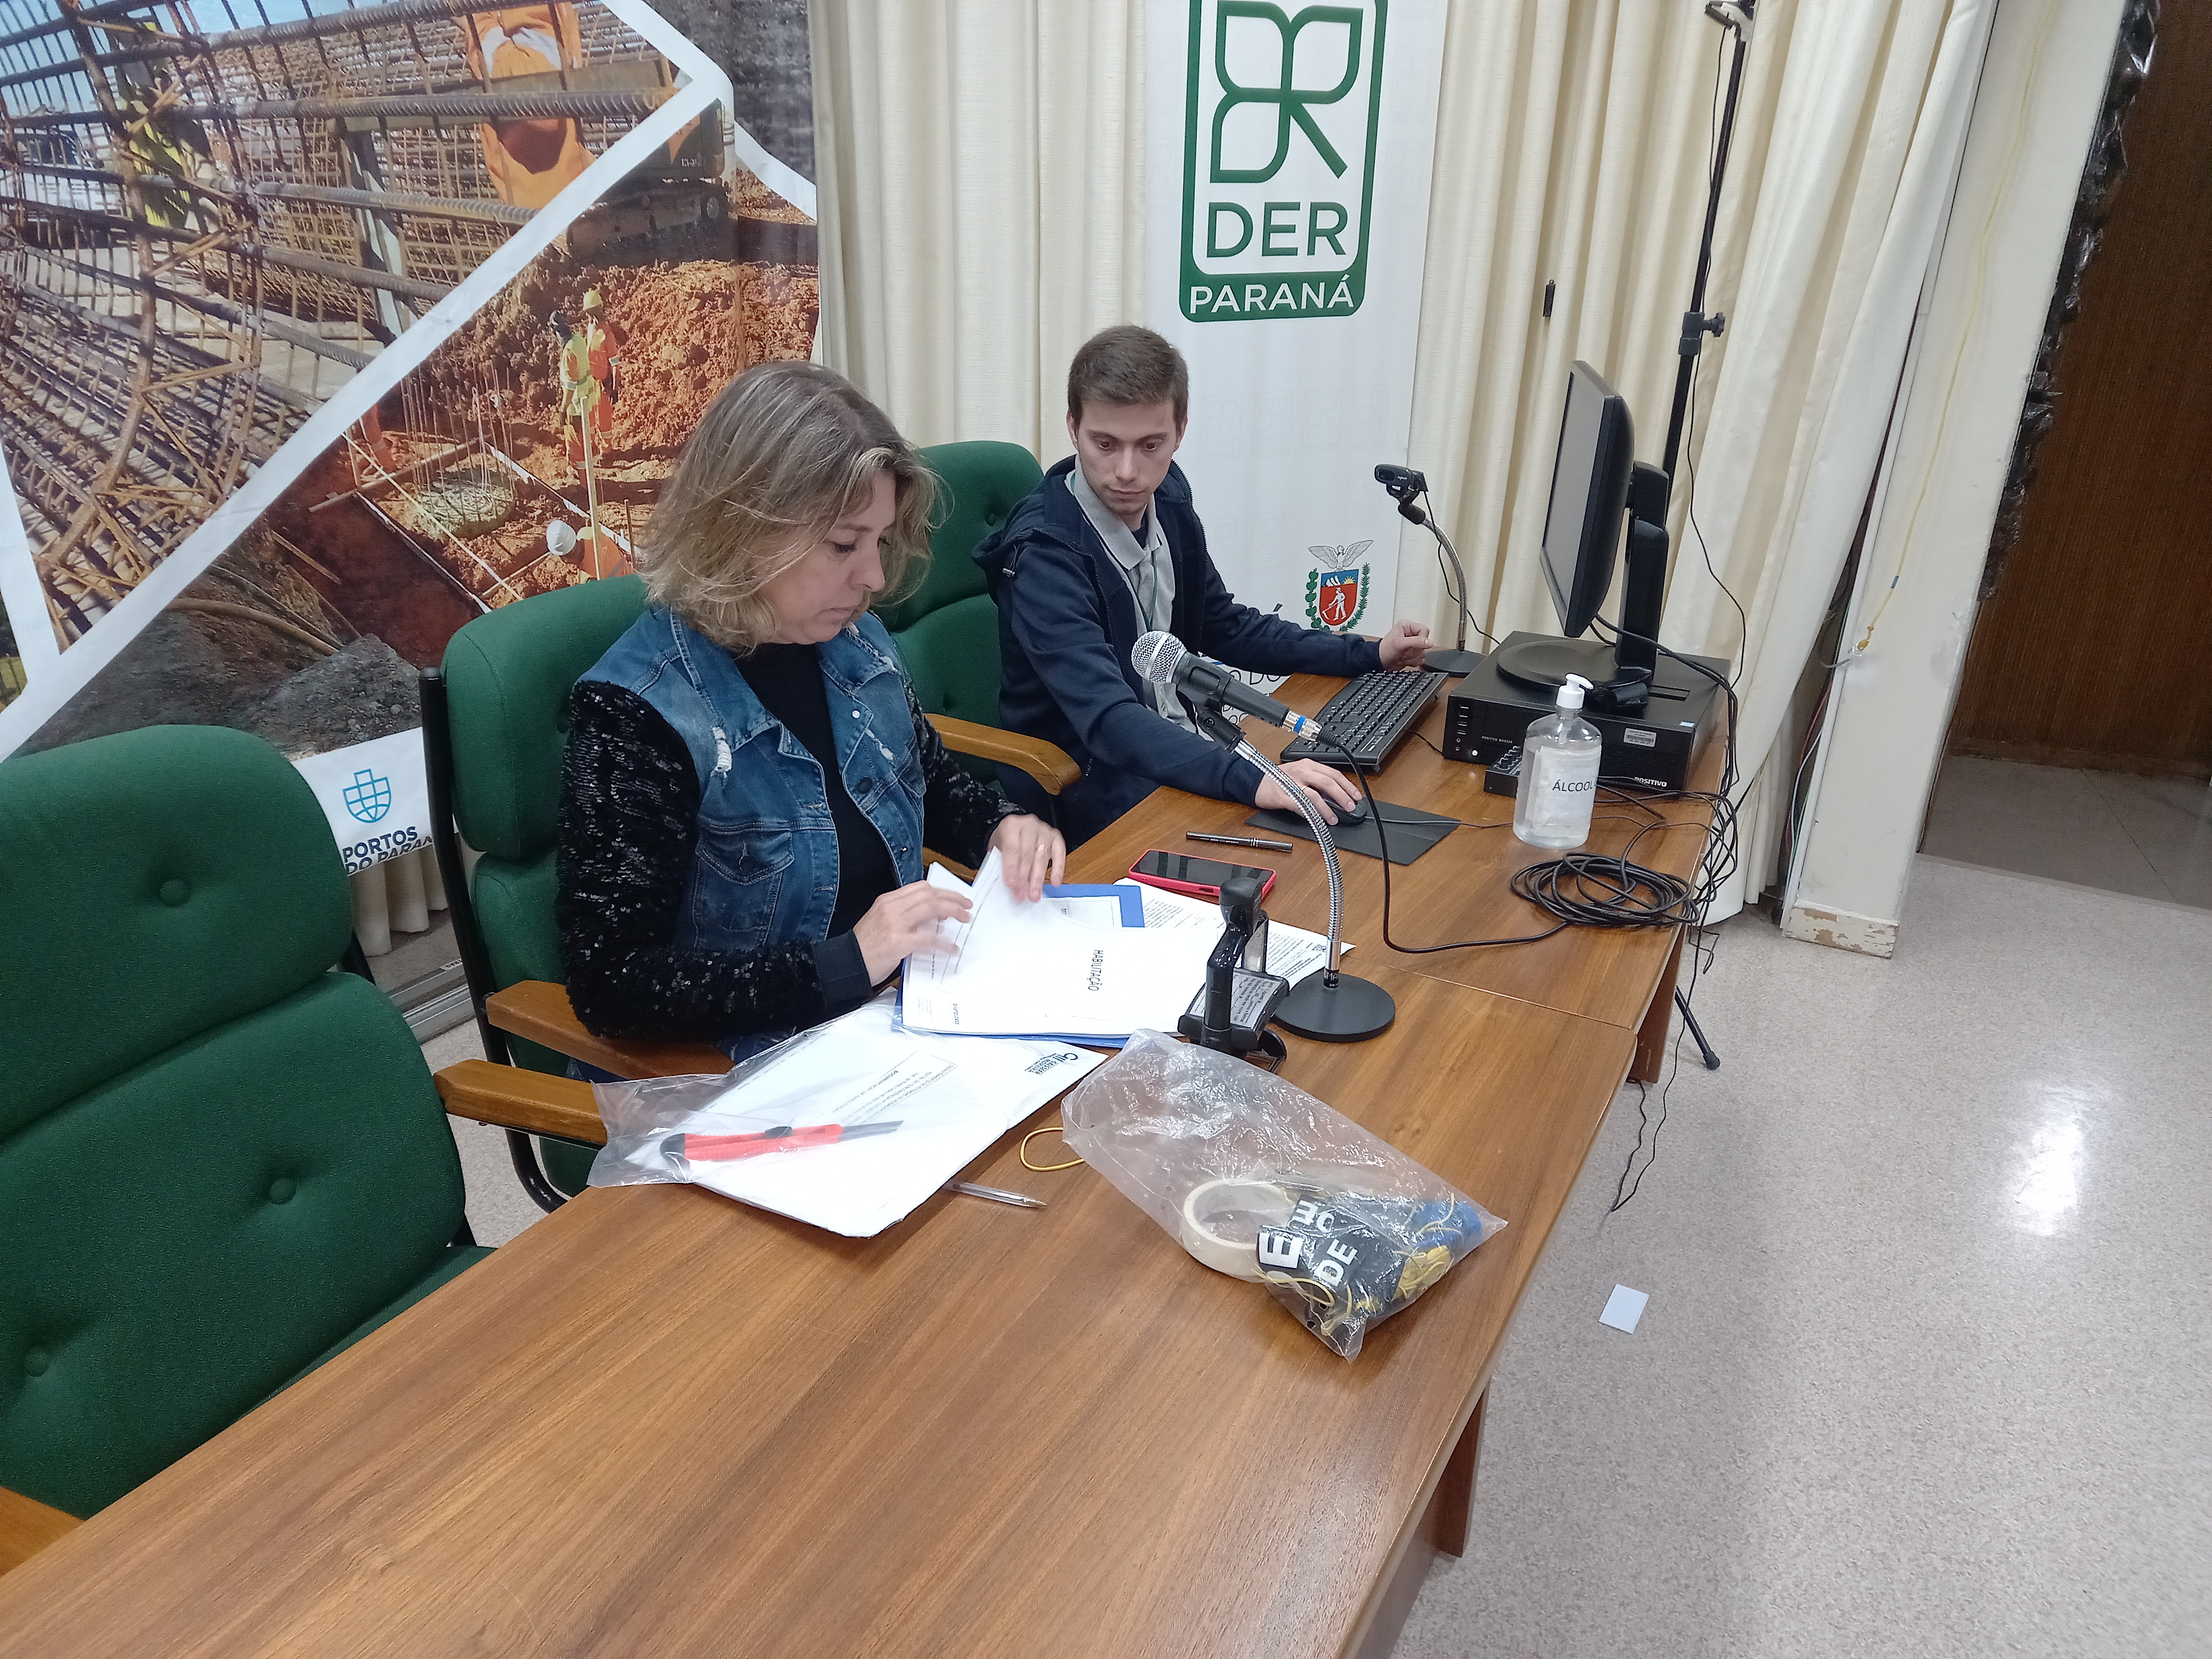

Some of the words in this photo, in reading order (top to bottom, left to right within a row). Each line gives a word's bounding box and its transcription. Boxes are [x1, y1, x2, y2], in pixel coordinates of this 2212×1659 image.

[1207, 201, 1348, 258] DER
[1190, 274, 1354, 314] PARANÁ
[1552, 779, 1593, 792] ÁLCOOL
[1634, 776, 1667, 787] POSITIVO
[342, 826, 418, 863] PORTOS
[345, 857, 372, 875] DO
[1087, 950, 1104, 991] HABILITAÇÃO
